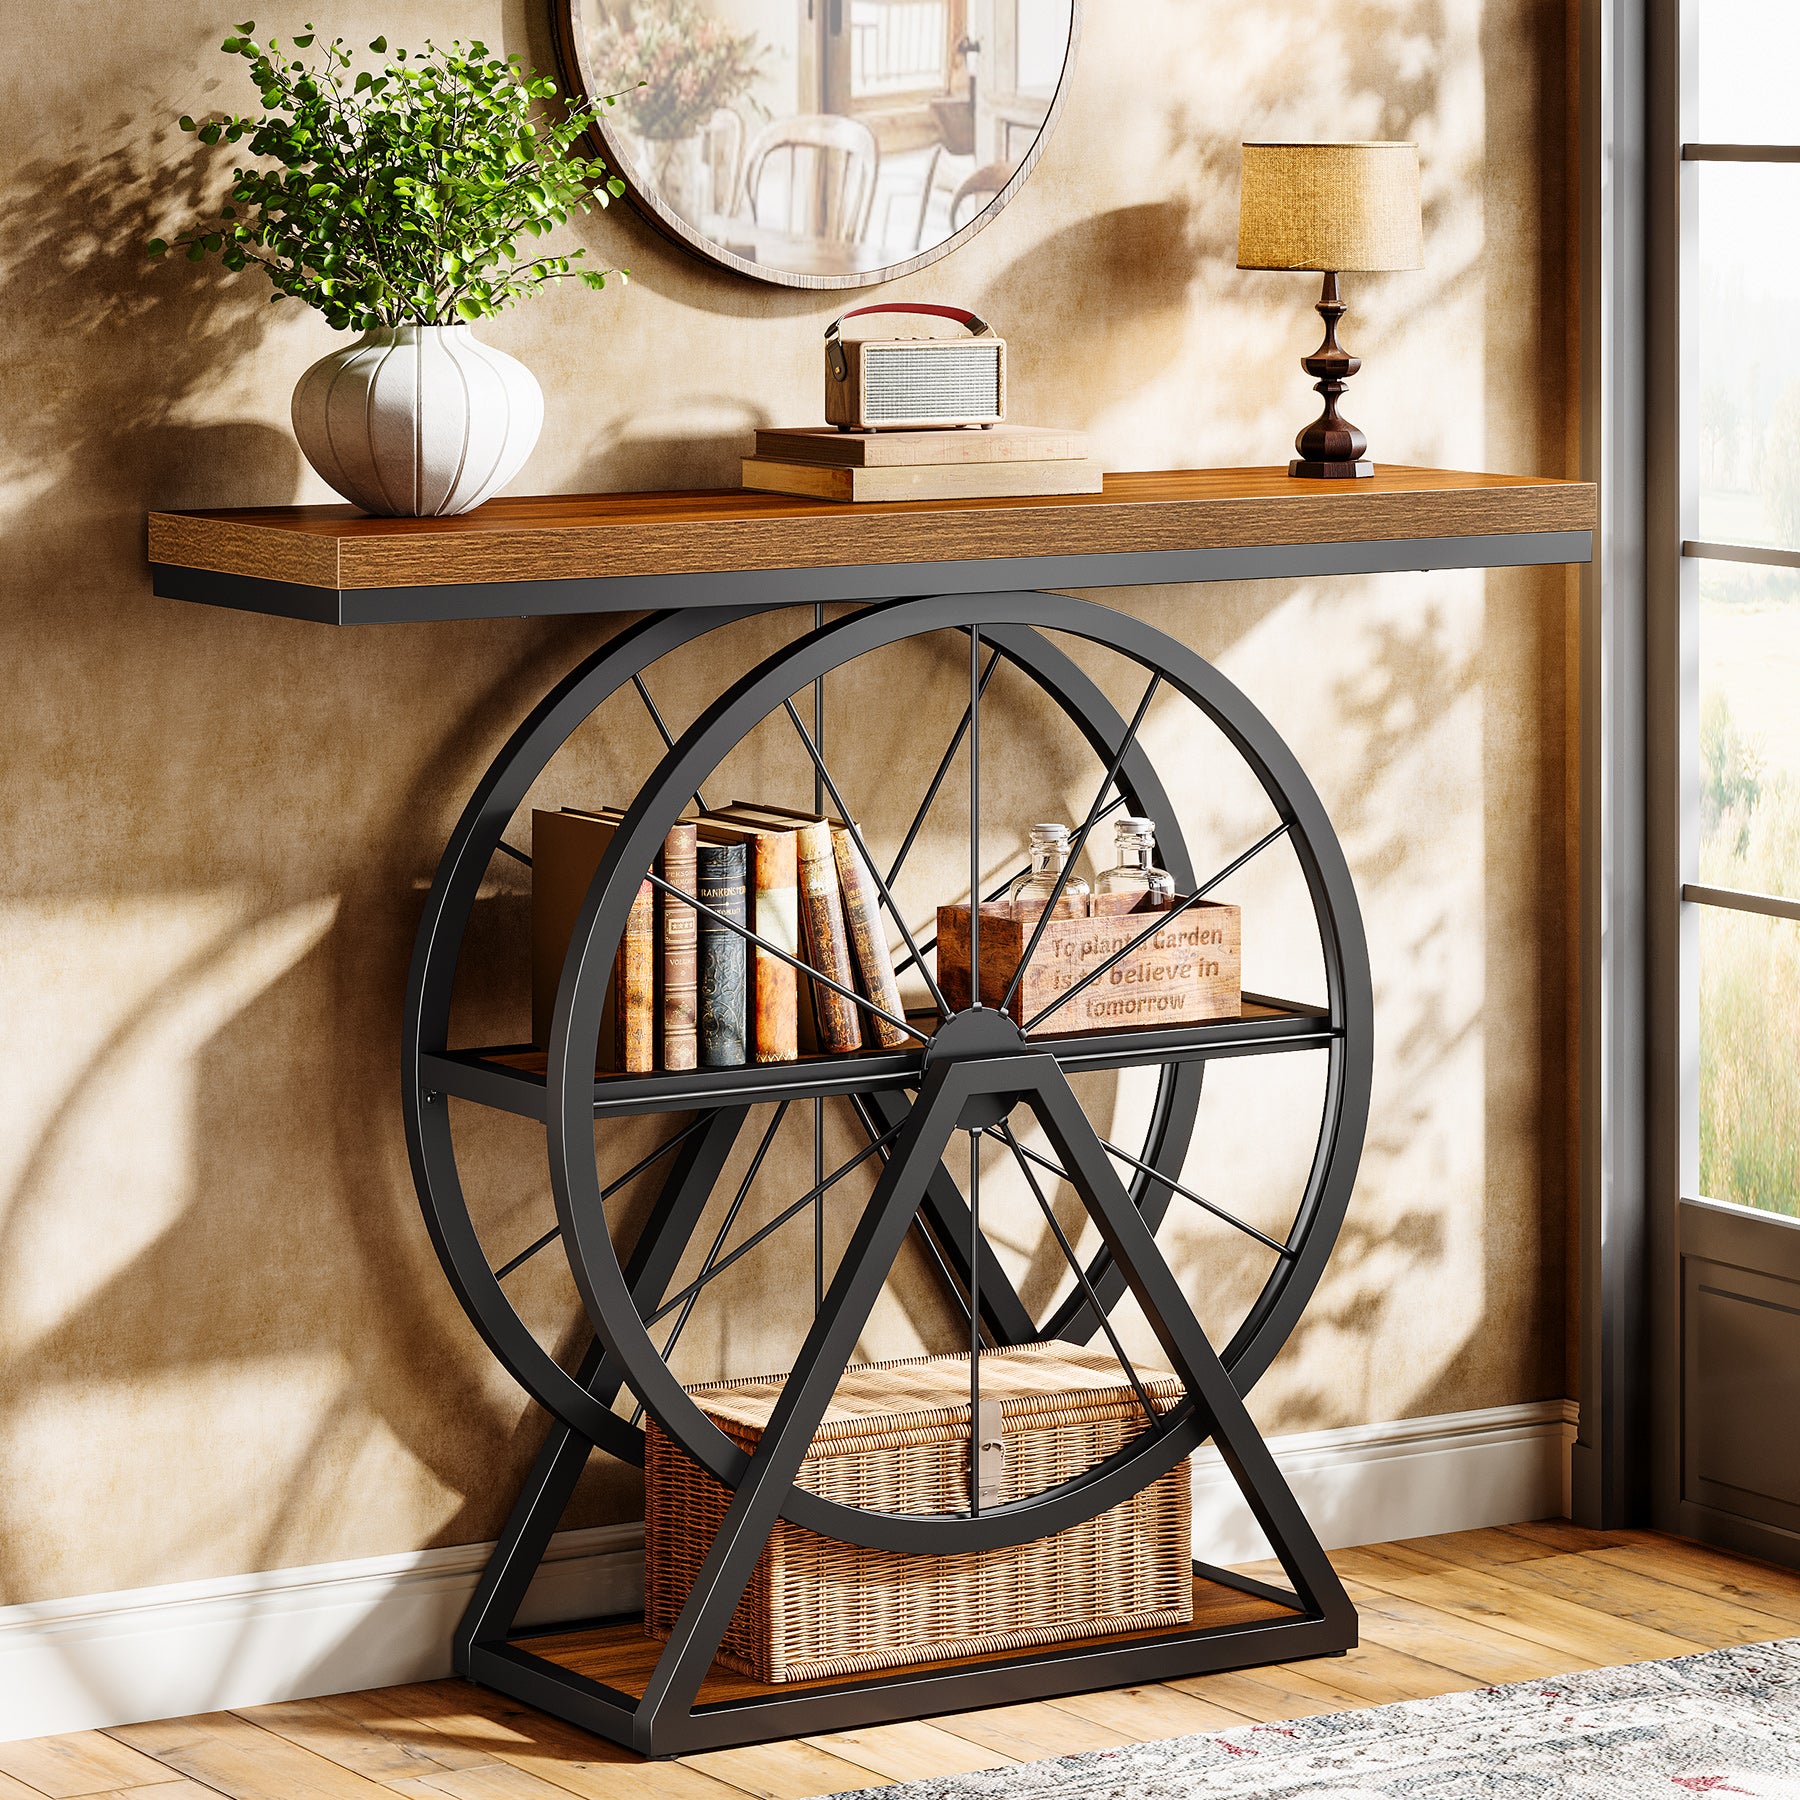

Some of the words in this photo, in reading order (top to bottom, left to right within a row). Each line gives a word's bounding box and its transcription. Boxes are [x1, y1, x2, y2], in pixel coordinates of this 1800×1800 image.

[1052, 937, 1075, 958] To
[1080, 932, 1132, 961] plant
[1152, 926, 1223, 950] Garden
[1053, 970, 1073, 990] is
[1109, 962, 1192, 986] believe
[1198, 957, 1219, 978] in
[1086, 994, 1187, 1018] tomorrow
